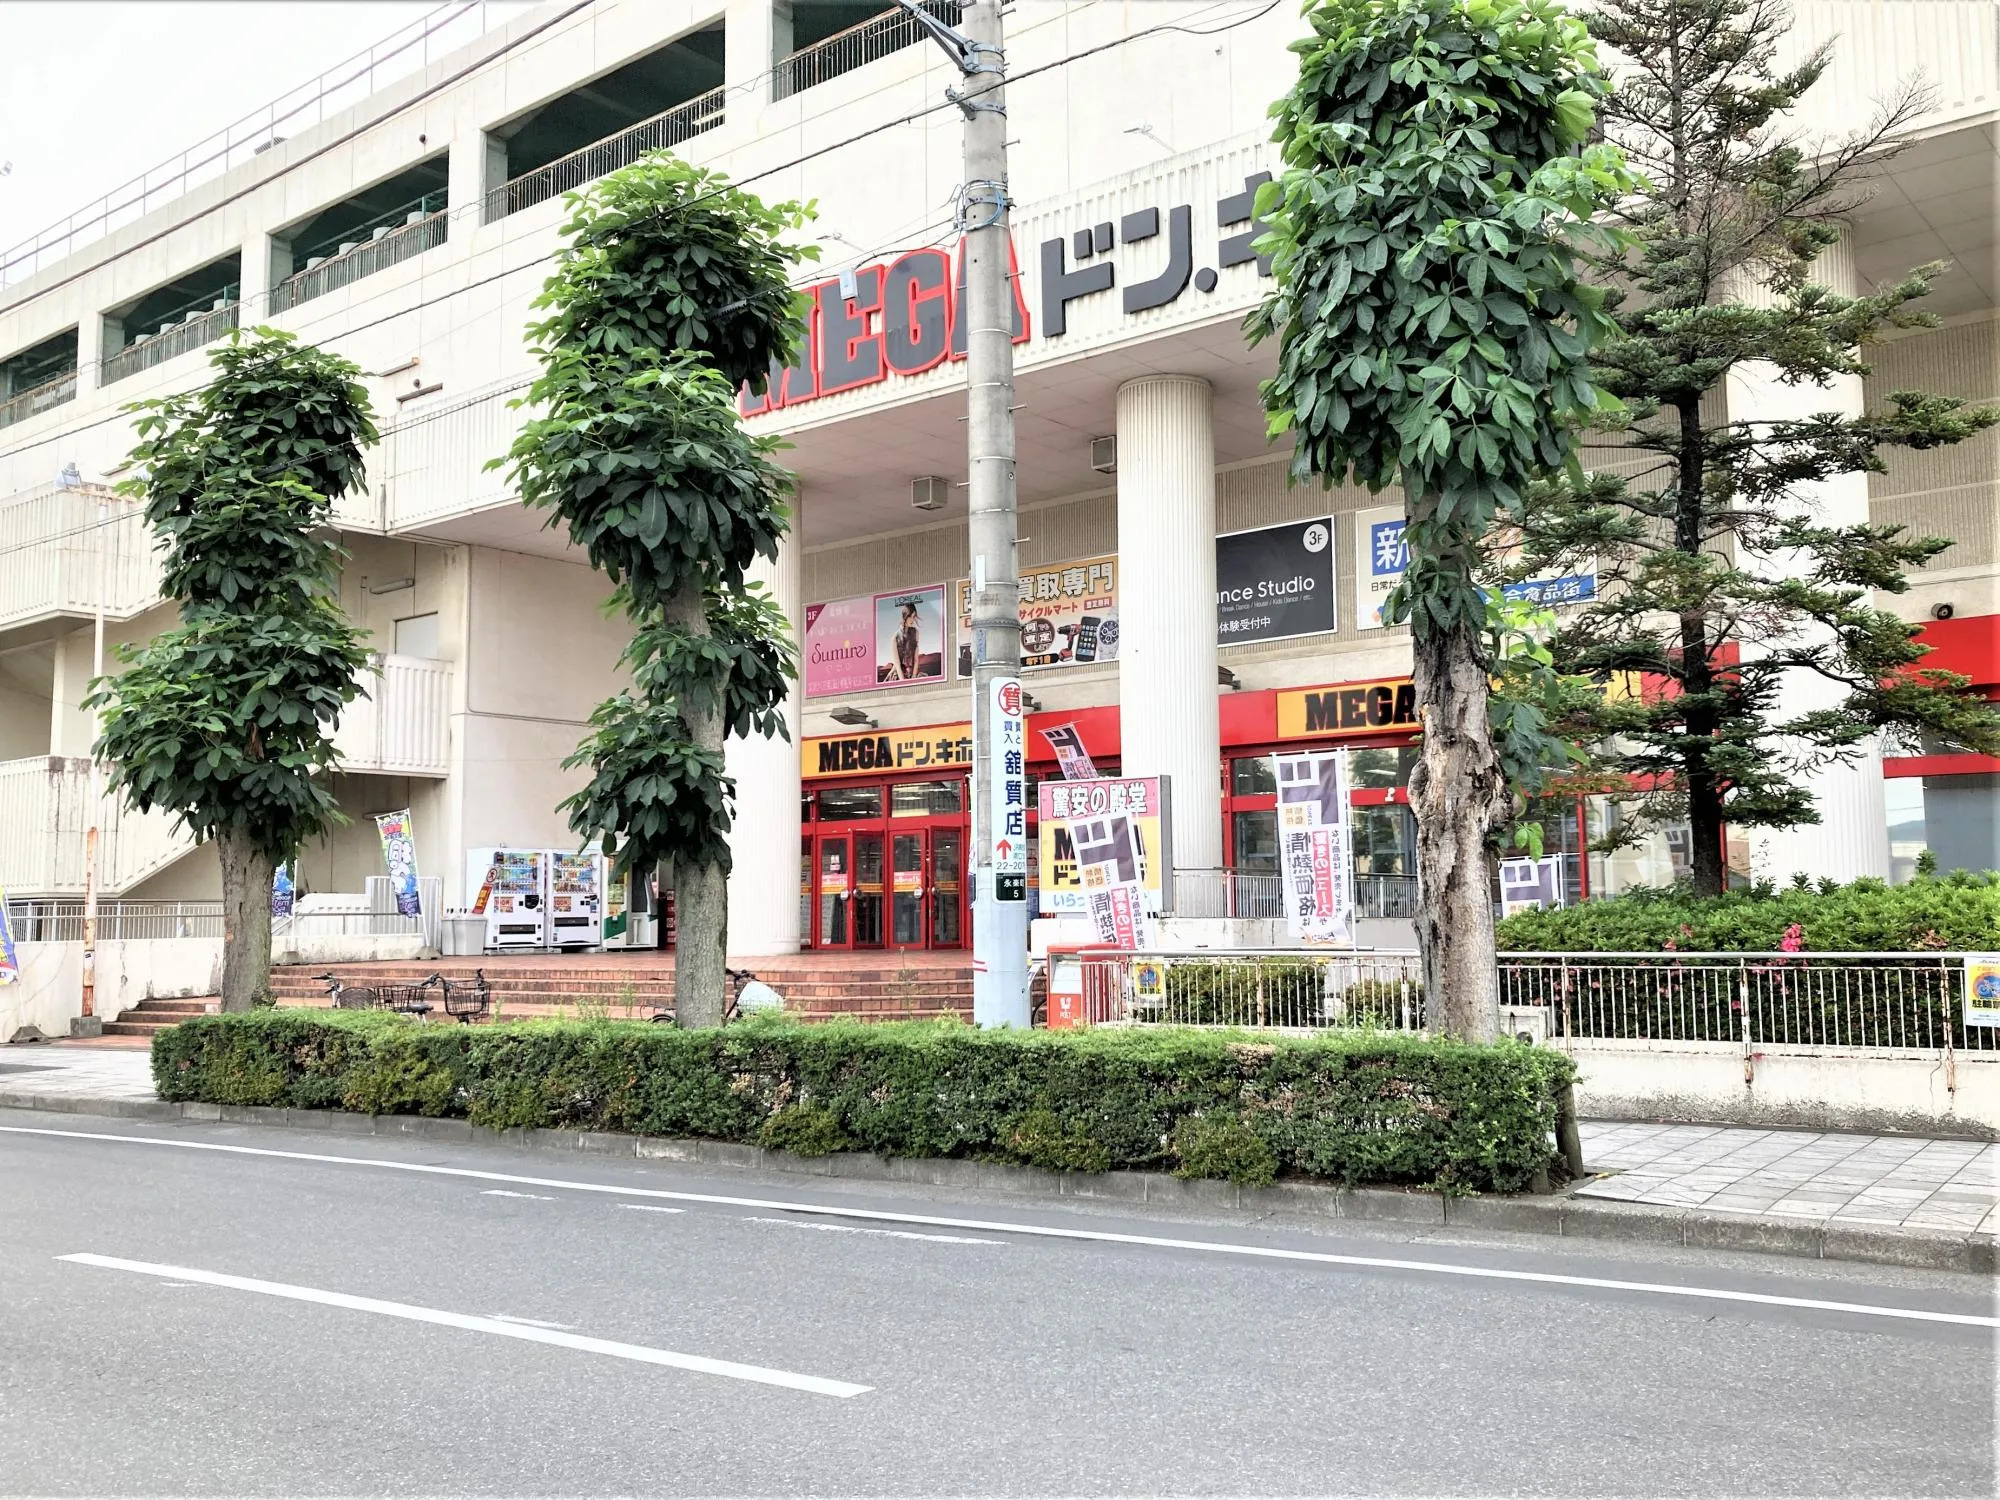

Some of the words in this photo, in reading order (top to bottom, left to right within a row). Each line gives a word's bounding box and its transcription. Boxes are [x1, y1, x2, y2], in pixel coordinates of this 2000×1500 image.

[1309, 530, 1323, 546] 3F
[1376, 527, 1411, 570] 新
[1018, 562, 1114, 604] 買取専門
[1258, 576, 1315, 598] Studio
[1019, 601, 1078, 620] サイクルマート
[1219, 616, 1271, 633] 体験受付中
[811, 641, 867, 664] Sumire
[1305, 684, 1416, 732] MEGA
[818, 736, 893, 773] MEGA
[1052, 782, 1147, 818] 驚安の殿堂
[1013, 889, 1019, 898] 5
